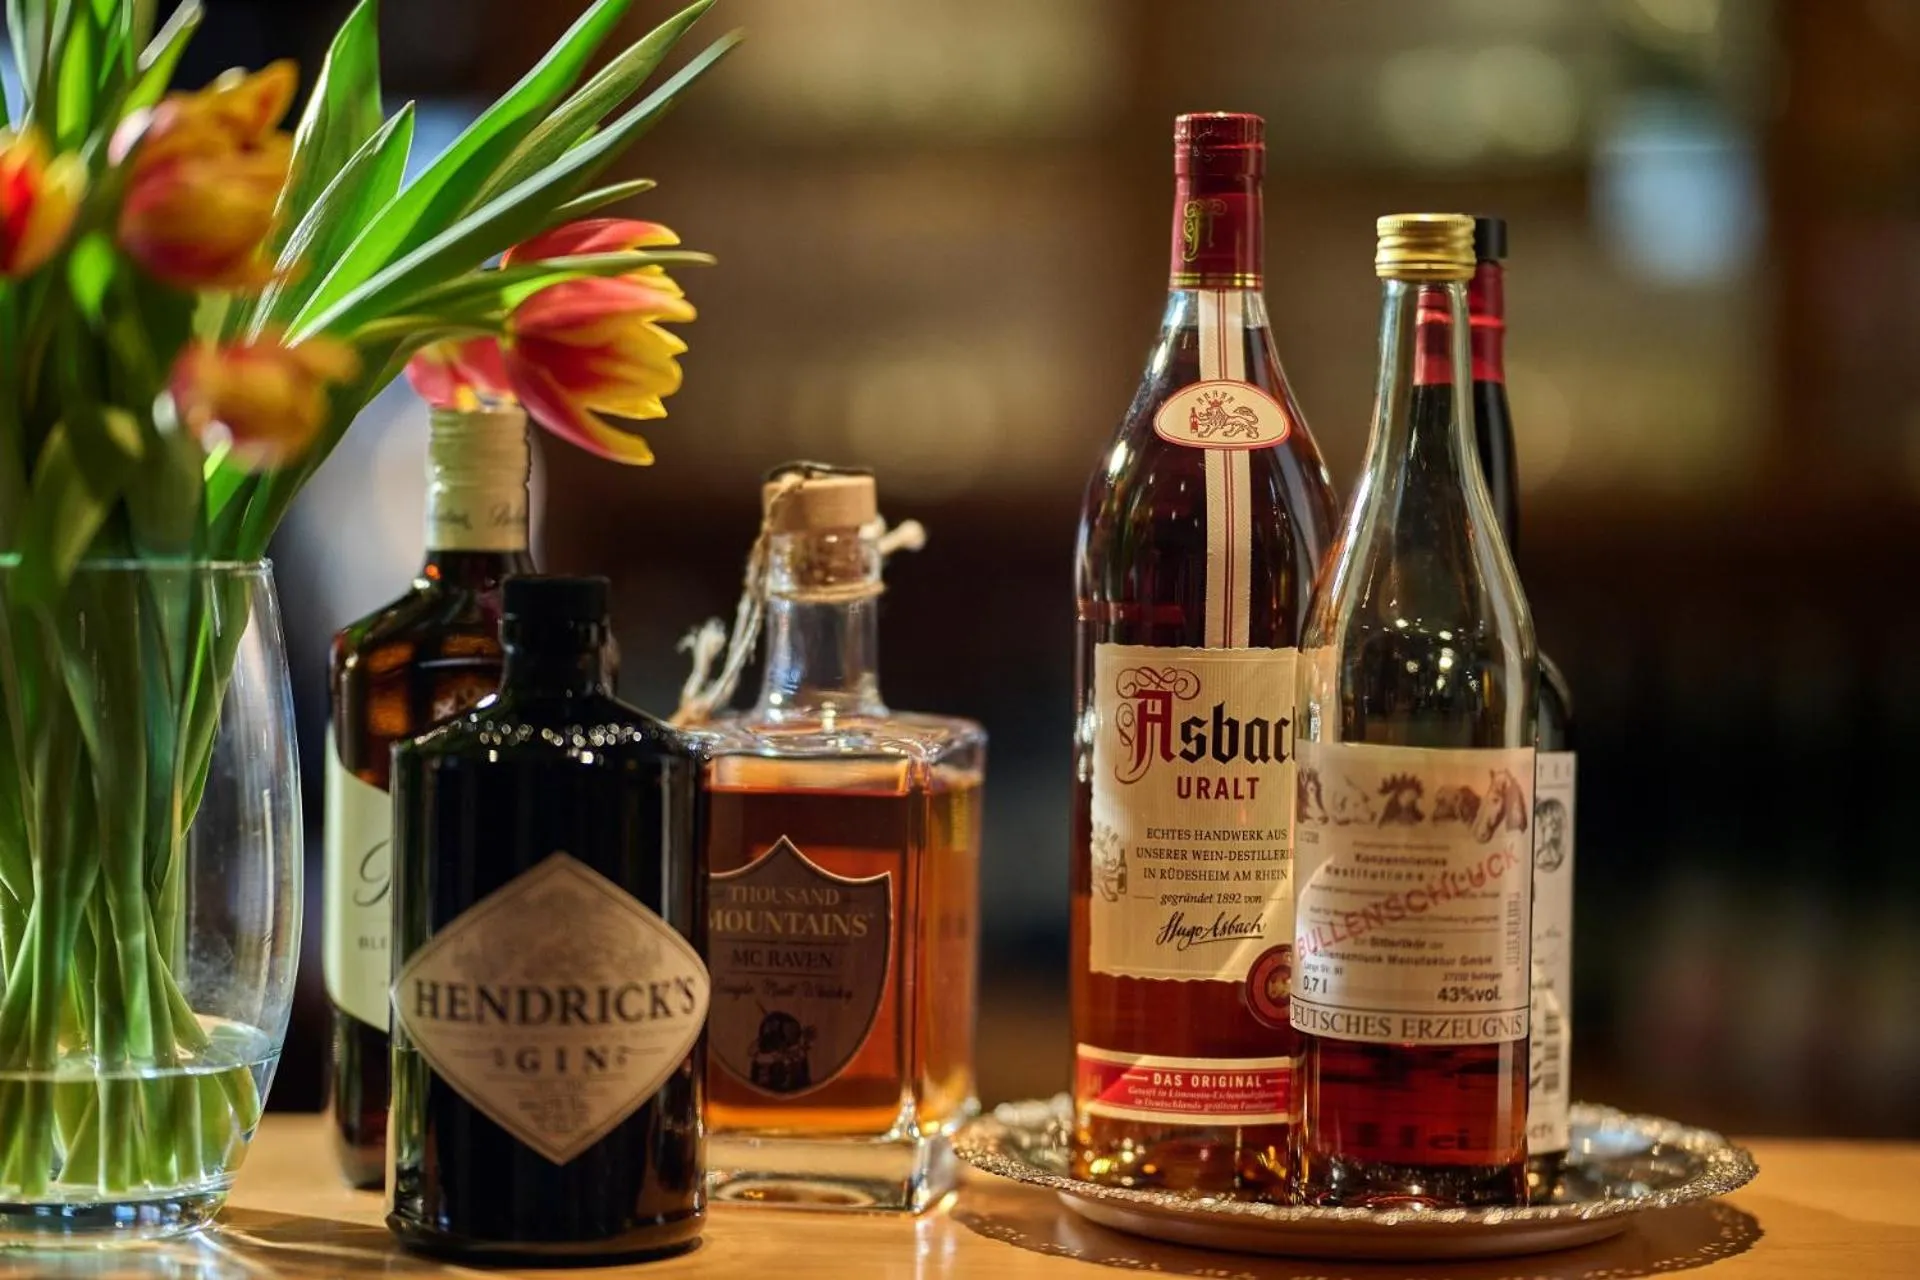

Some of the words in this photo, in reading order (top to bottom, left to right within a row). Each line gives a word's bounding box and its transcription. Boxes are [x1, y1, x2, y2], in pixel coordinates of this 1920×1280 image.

[1115, 688, 1296, 784] Asbac
[1177, 776, 1260, 800] URALT
[1146, 828, 1191, 840] ECHTES
[1194, 829, 1263, 841] HANDWERK
[1266, 828, 1288, 841] AUS
[1136, 847, 1188, 861] UNSERER
[1143, 867, 1156, 879] IN
[1159, 867, 1230, 881] RÜDESHEIM
[1233, 868, 1251, 881] AM
[1255, 868, 1288, 880] RHEIN
[731, 885, 839, 906] THOUSAND
[1160, 892, 1213, 905] gegründet
[1216, 892, 1241, 904] 1892
[1244, 894, 1262, 904] von
[1296, 843, 1521, 960] BULLENSCHLUCK
[709, 909, 868, 937] MOUNTAINS
[1155, 911, 1203, 951] Hugo
[1201, 911, 1266, 939] Asbach
[768, 951, 833, 969] RAVEN
[414, 976, 698, 1027] HENDRICK'S
[1402, 1014, 1523, 1039] ERZEUGNIS
[515, 1045, 608, 1075] GIN
[1153, 1072, 1183, 1086] DAS
[1191, 1074, 1262, 1088] ORIGINAL
